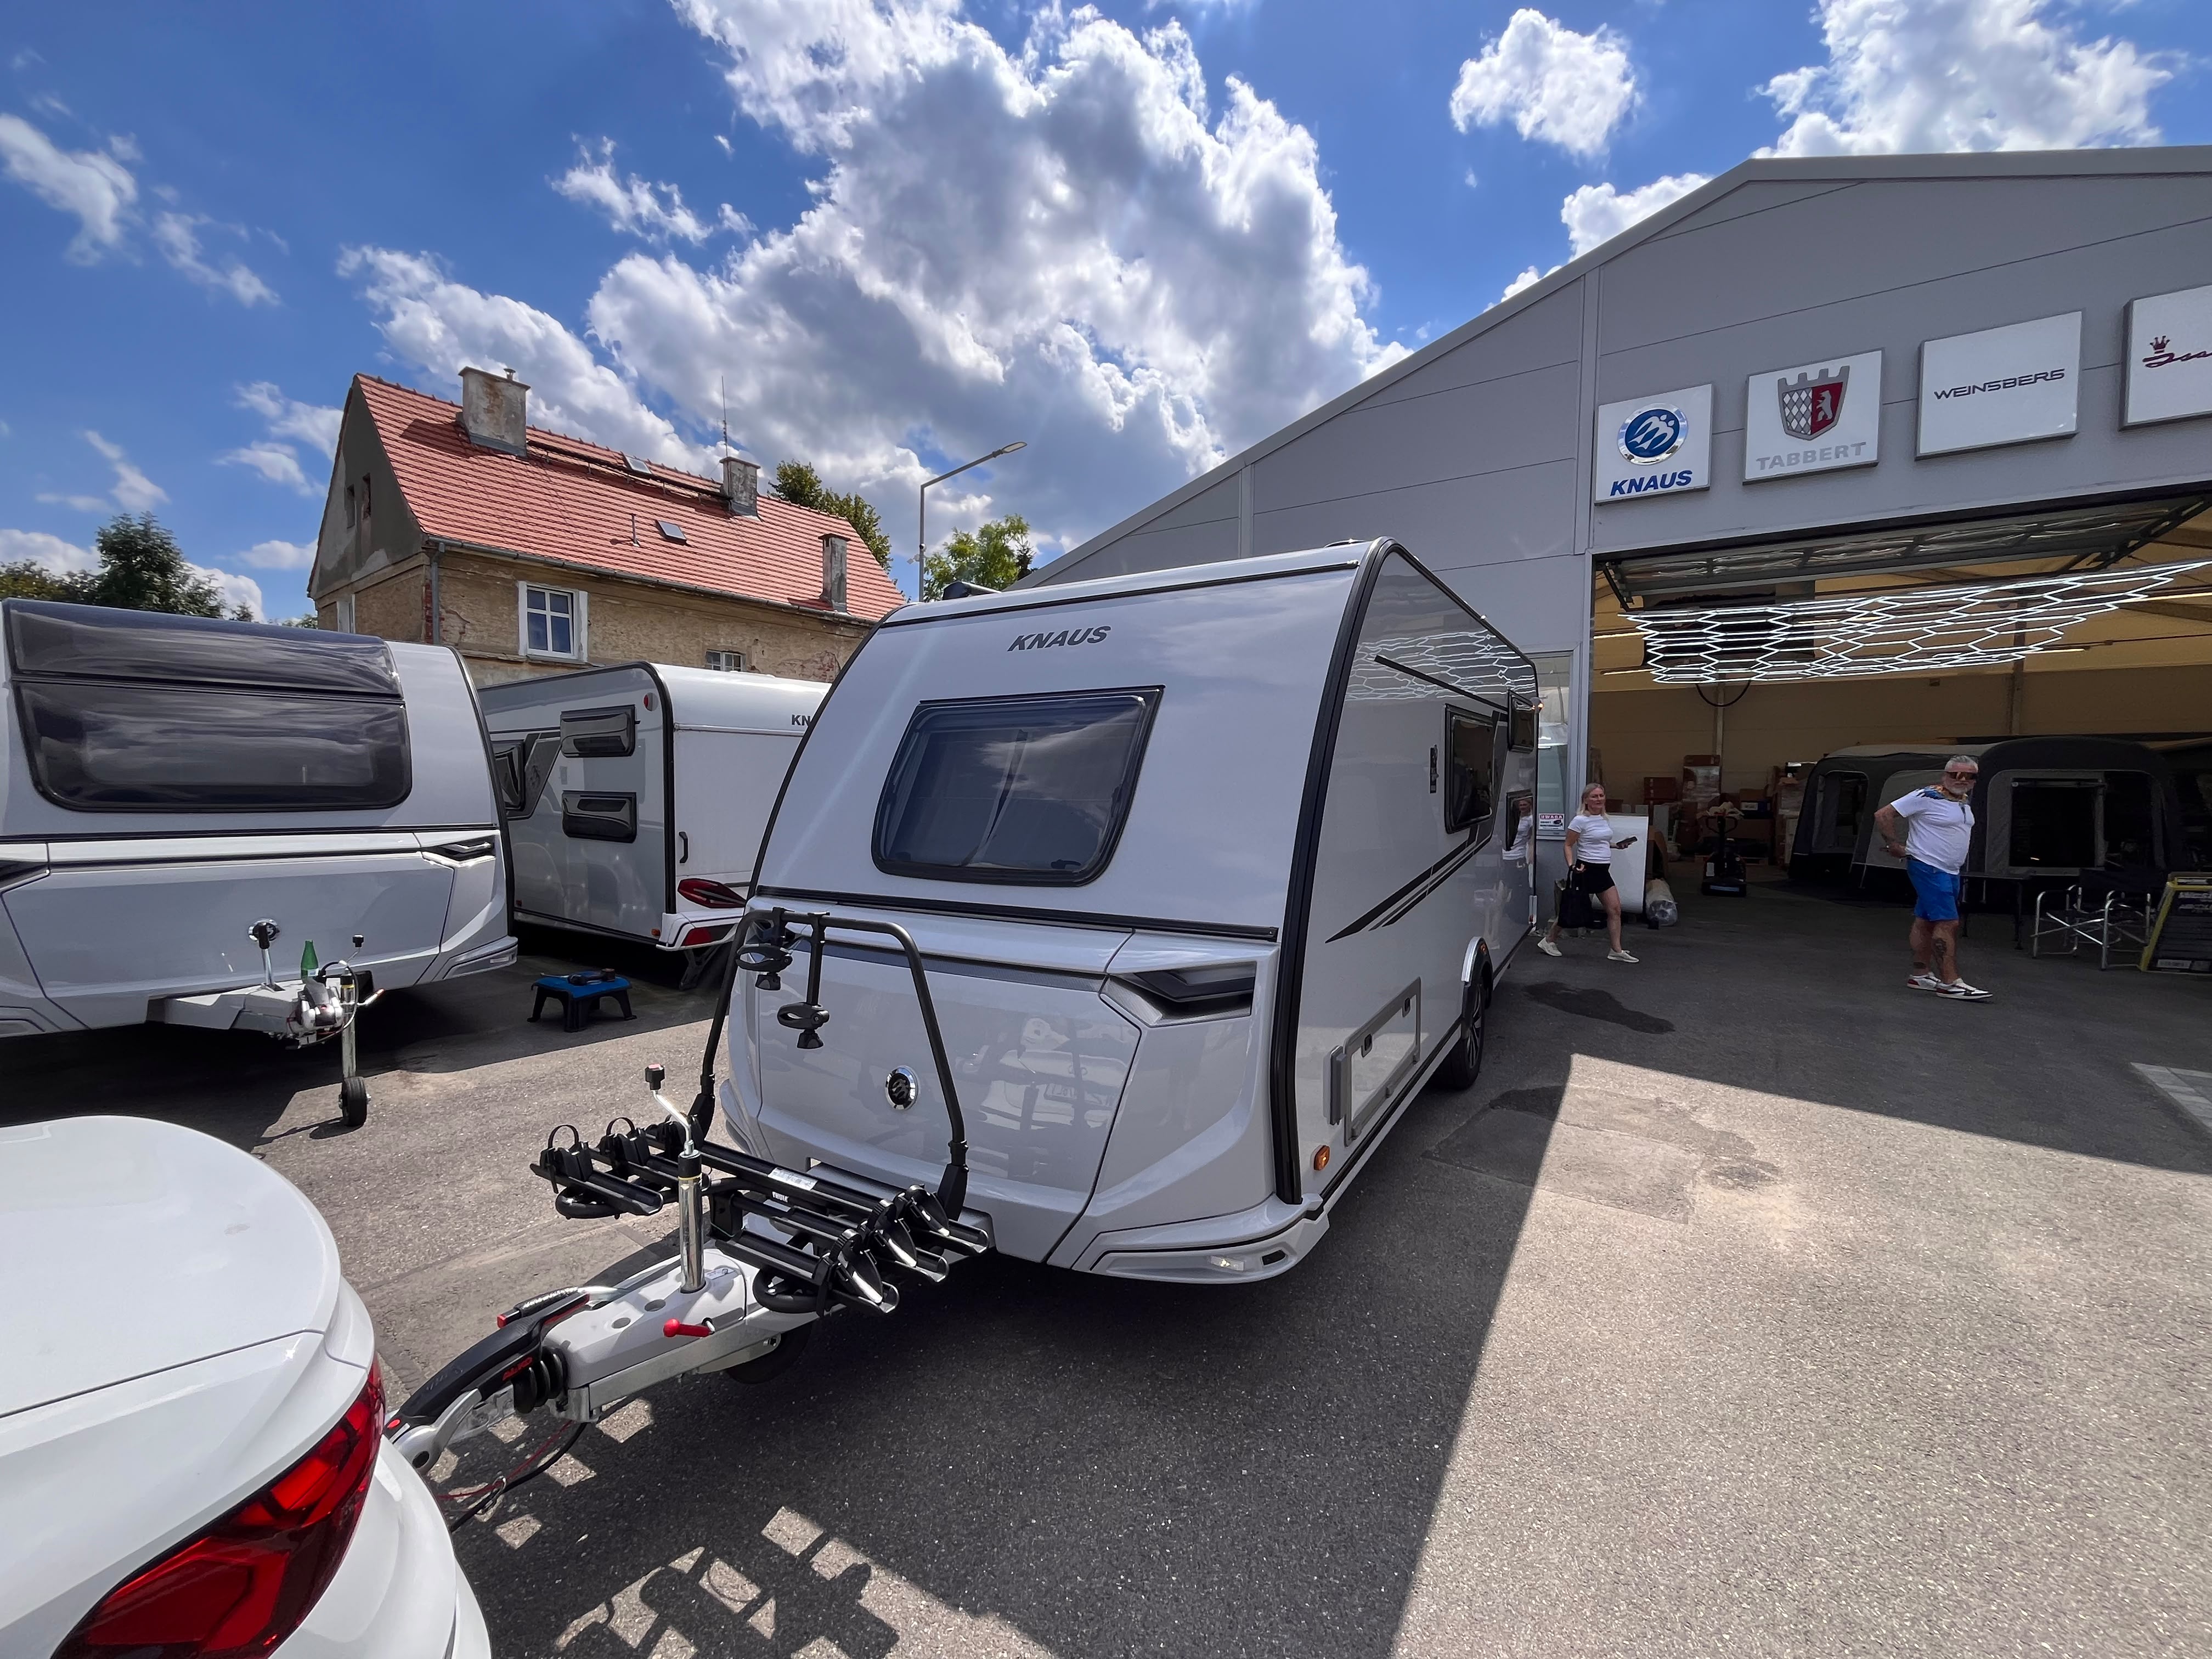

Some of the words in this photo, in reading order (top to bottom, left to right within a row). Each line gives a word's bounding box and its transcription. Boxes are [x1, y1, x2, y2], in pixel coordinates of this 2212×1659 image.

[1756, 442, 1866, 471] TABBERT
[1610, 470, 1692, 496] KNAUS
[1007, 625, 1111, 652] KNAUS
[791, 714, 811, 726] KN
